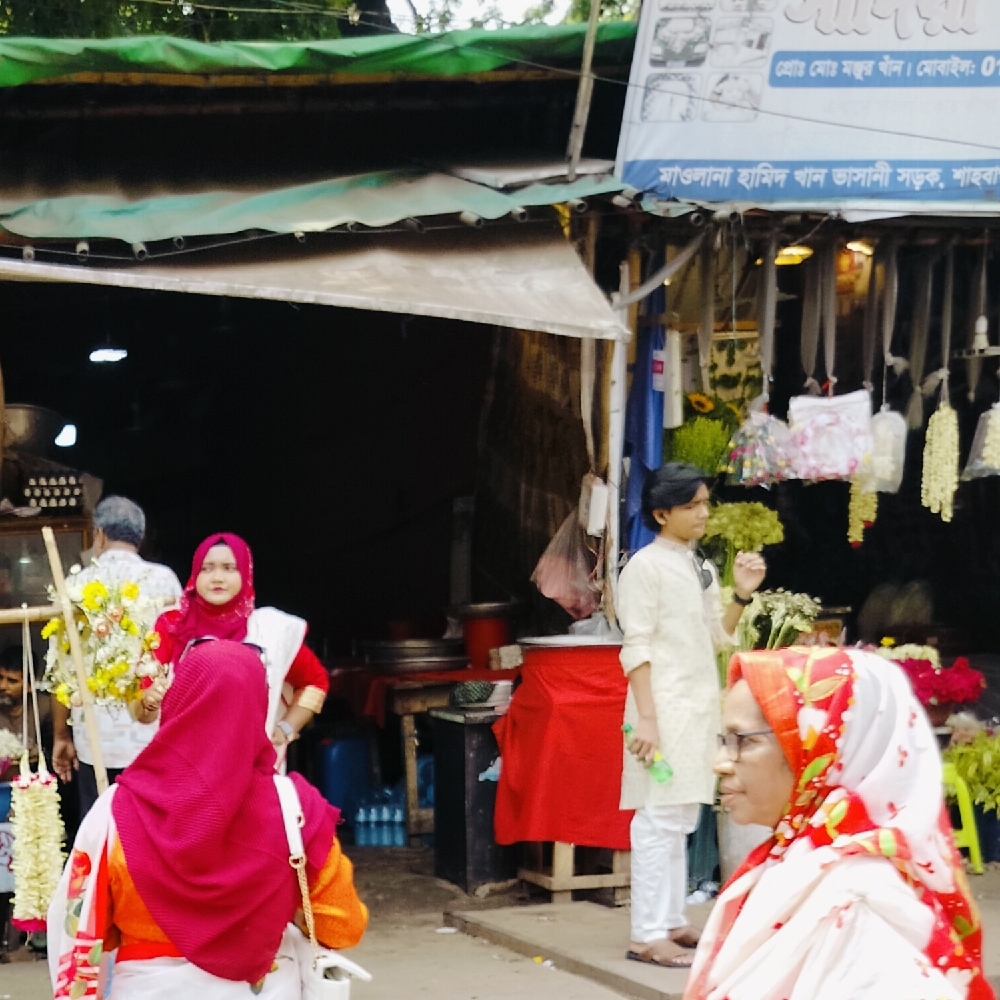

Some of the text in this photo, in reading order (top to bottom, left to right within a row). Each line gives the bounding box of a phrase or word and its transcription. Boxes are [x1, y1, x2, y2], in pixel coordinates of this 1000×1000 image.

[659, 166, 733, 187] মাওলানা
[737, 163, 789, 189] হামিদ
[794, 167, 827, 188] খান
[832, 160, 892, 187] ভাসানী
[951, 165, 1000, 189] শাহবা
